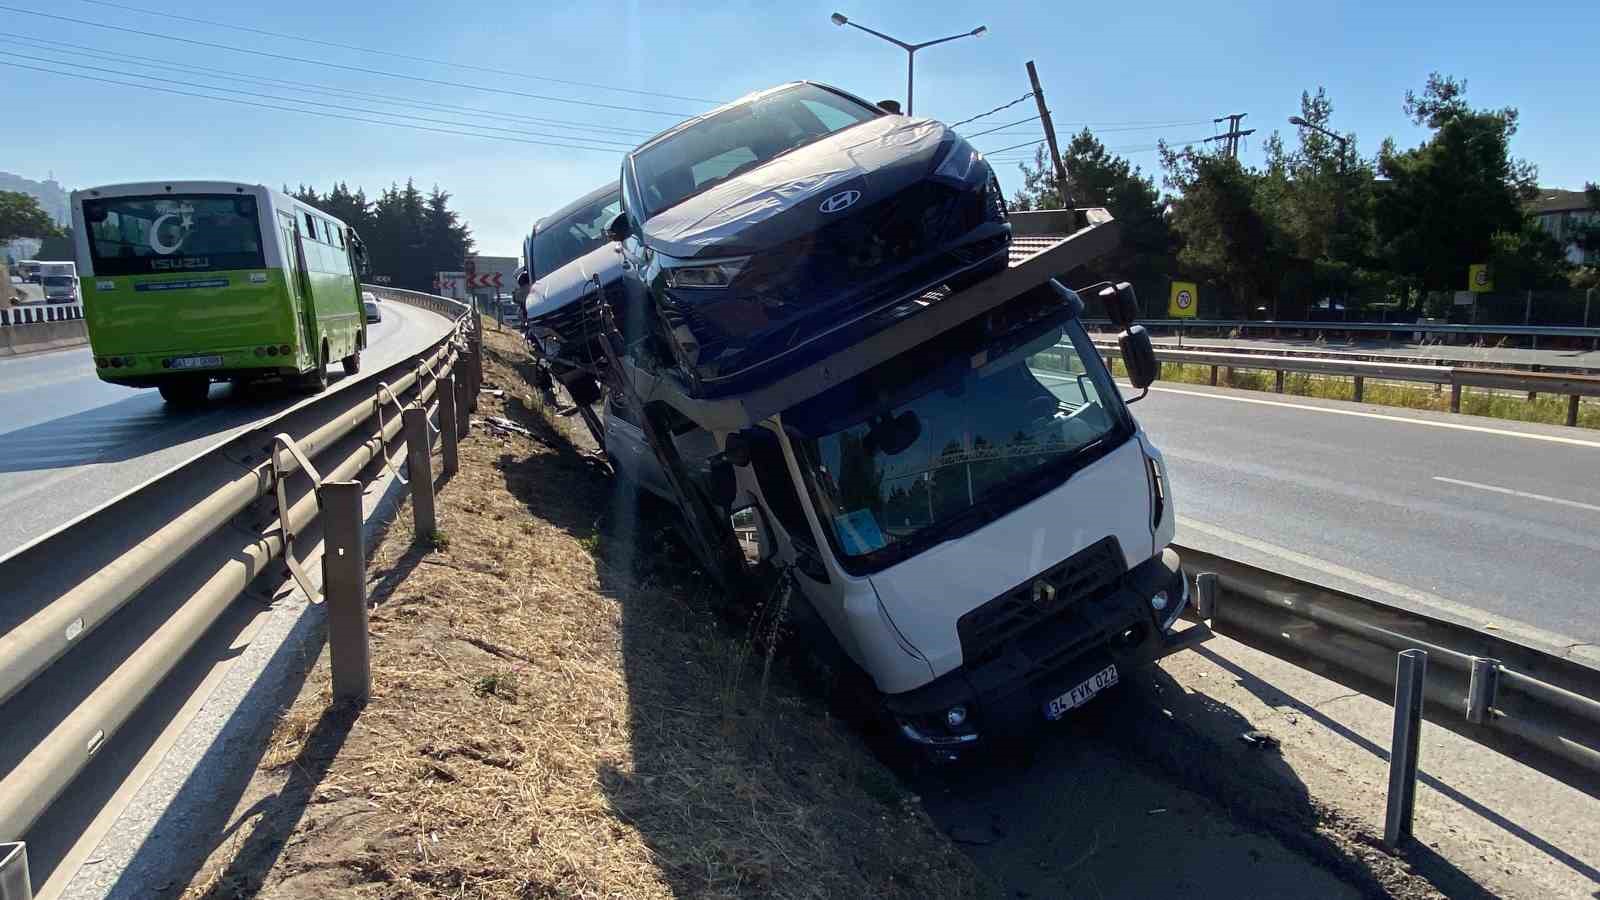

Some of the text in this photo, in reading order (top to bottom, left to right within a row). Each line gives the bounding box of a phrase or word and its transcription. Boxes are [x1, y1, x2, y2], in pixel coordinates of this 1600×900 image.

[151, 256, 209, 269] ISUZU
[1179, 294, 1190, 305] 70
[1051, 667, 1117, 714] 34 FVK 022
